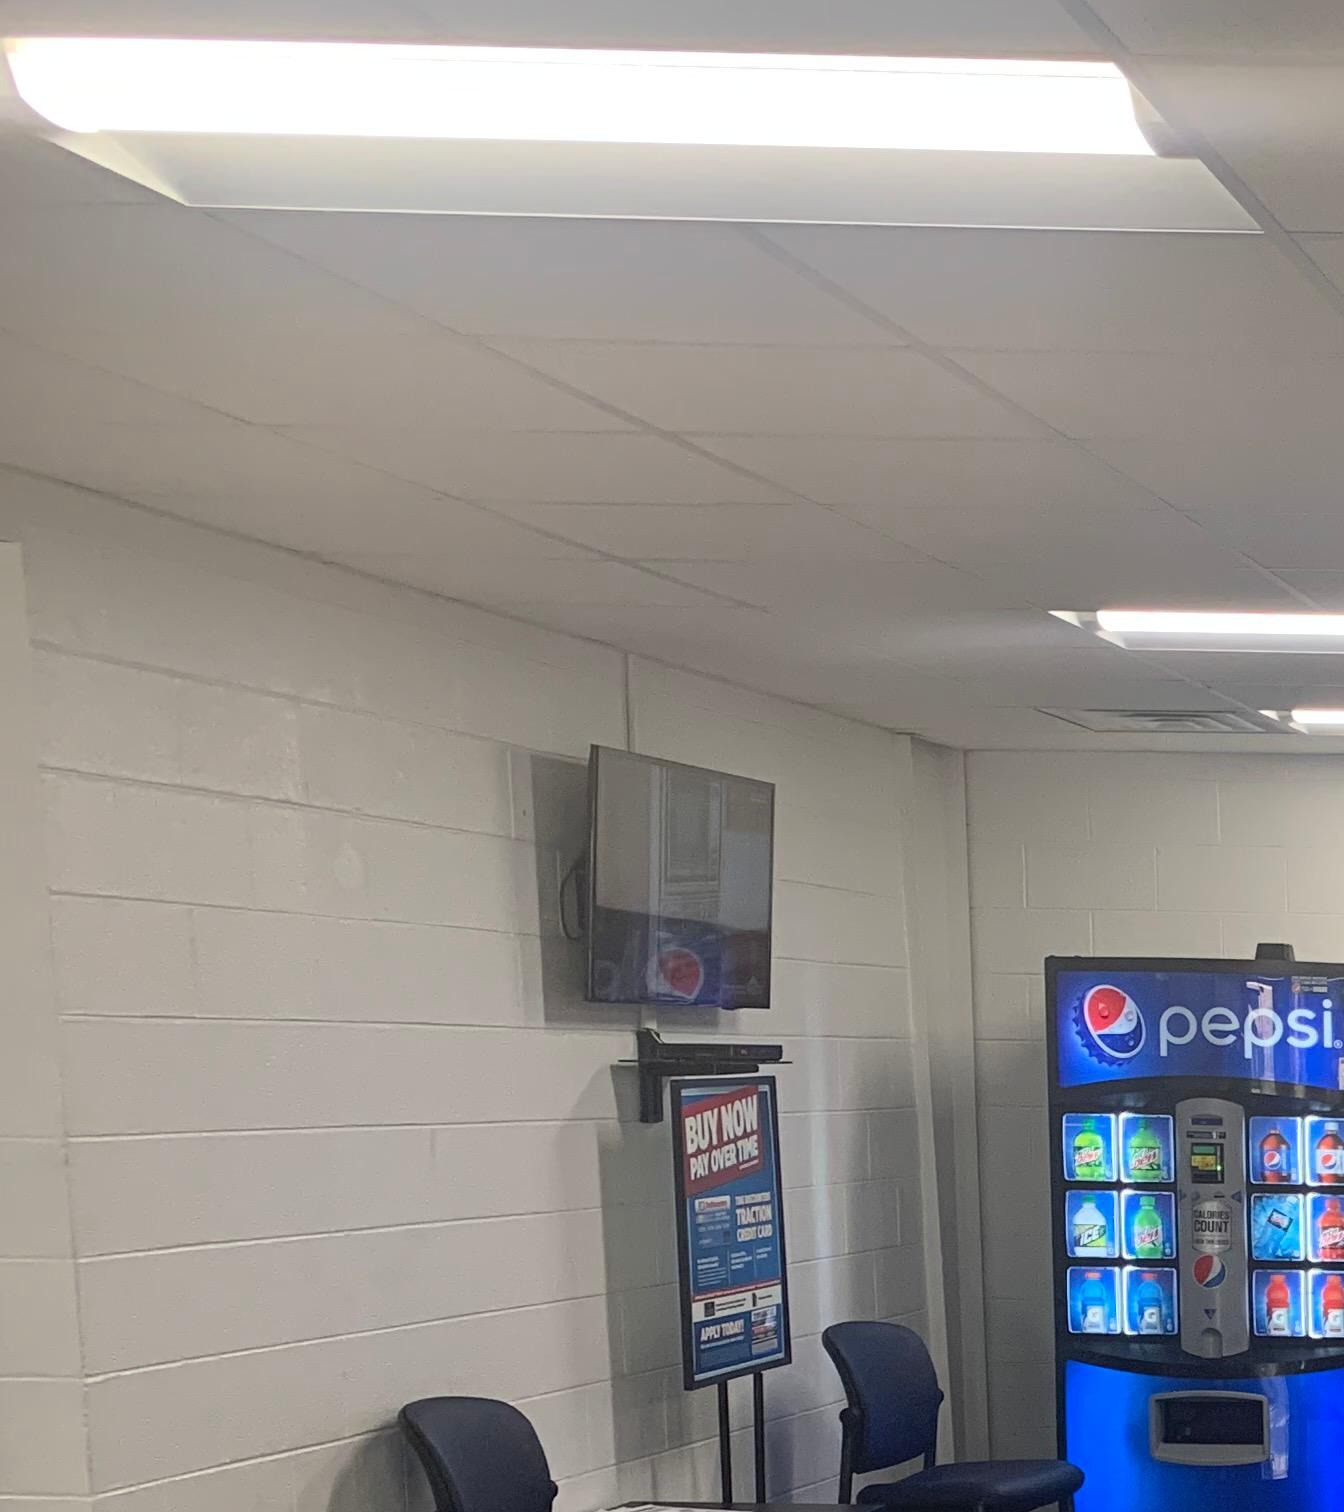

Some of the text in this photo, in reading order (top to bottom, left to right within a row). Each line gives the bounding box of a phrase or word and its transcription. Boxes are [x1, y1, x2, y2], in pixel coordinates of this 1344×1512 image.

[1159, 999, 1333, 1059] pepsi
[685, 1094, 758, 1155] BUY NOW
[689, 1134, 759, 1181] PAY OVER TIME
[1193, 1220, 1230, 1233] COUNT
[700, 1321, 721, 1342] APPLY
